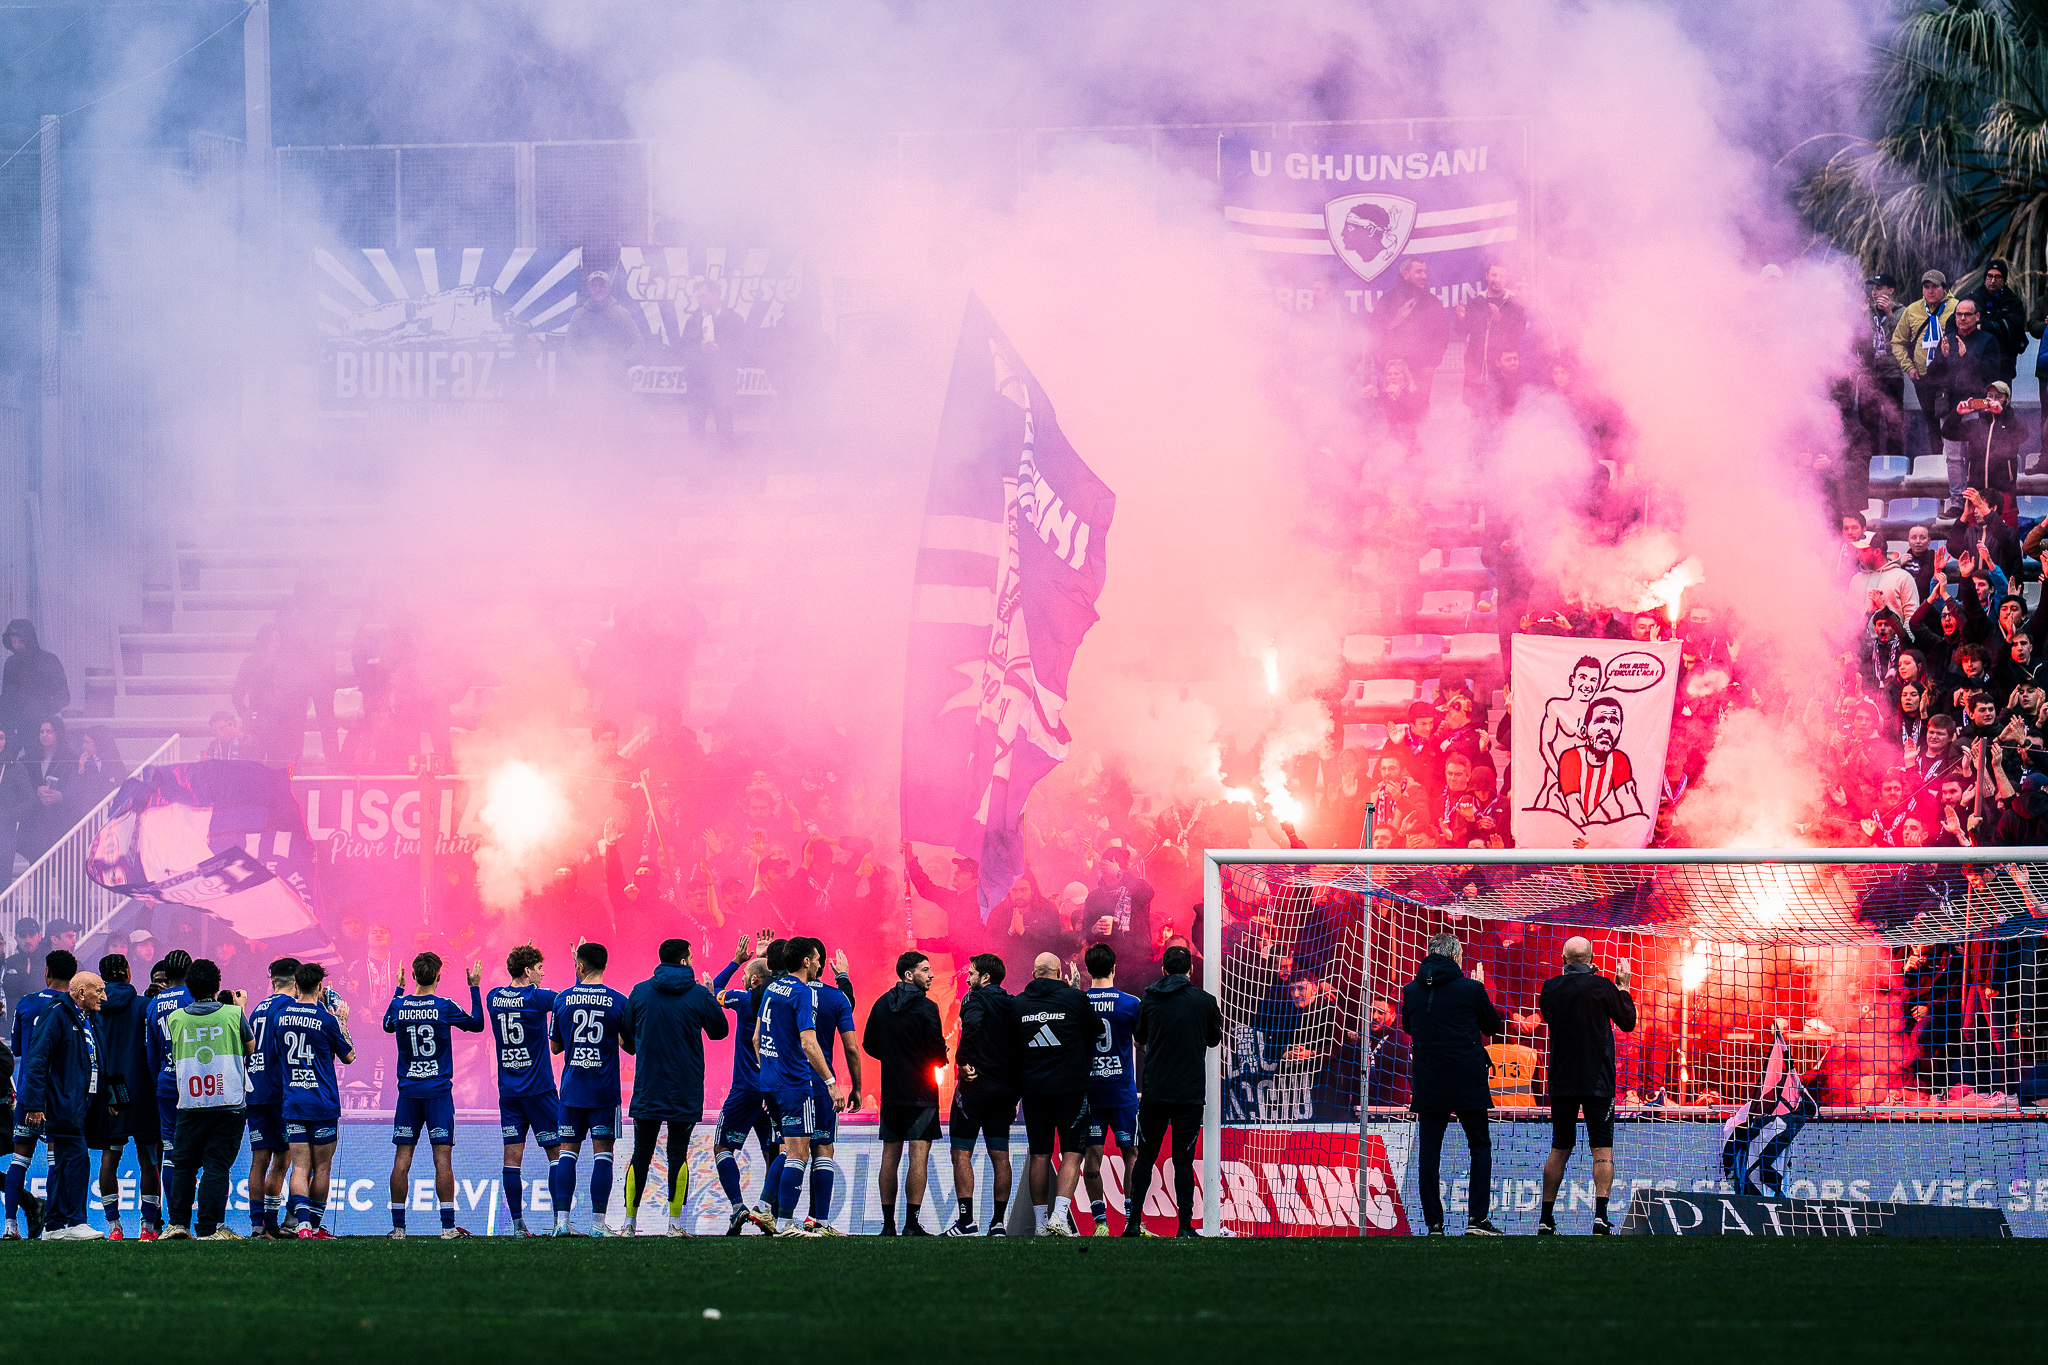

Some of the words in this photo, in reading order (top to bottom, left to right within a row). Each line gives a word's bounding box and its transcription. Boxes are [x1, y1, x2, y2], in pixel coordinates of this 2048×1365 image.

[1250, 149, 1272, 177] U
[1284, 145, 1488, 182] GHJUNSANI
[329, 831, 388, 864] Pieve
[157, 999, 178, 1013] ETOGA
[398, 1008, 439, 1020] DUCROCQ
[492, 997, 525, 1008] BOHNERT
[565, 994, 613, 1007] RODRIGUES
[761, 996, 772, 1032] 4
[183, 1026, 224, 1043] LFP
[278, 1015, 323, 1031] MEYNADIER
[497, 1012, 525, 1045] 15
[573, 1009, 605, 1044] 25
[283, 1031, 315, 1066] 24
[406, 1024, 437, 1057] 13
[188, 1074, 216, 1098] 09
[216, 1073, 224, 1096] PHOTO
[1262, 1163, 1398, 1230] KING
